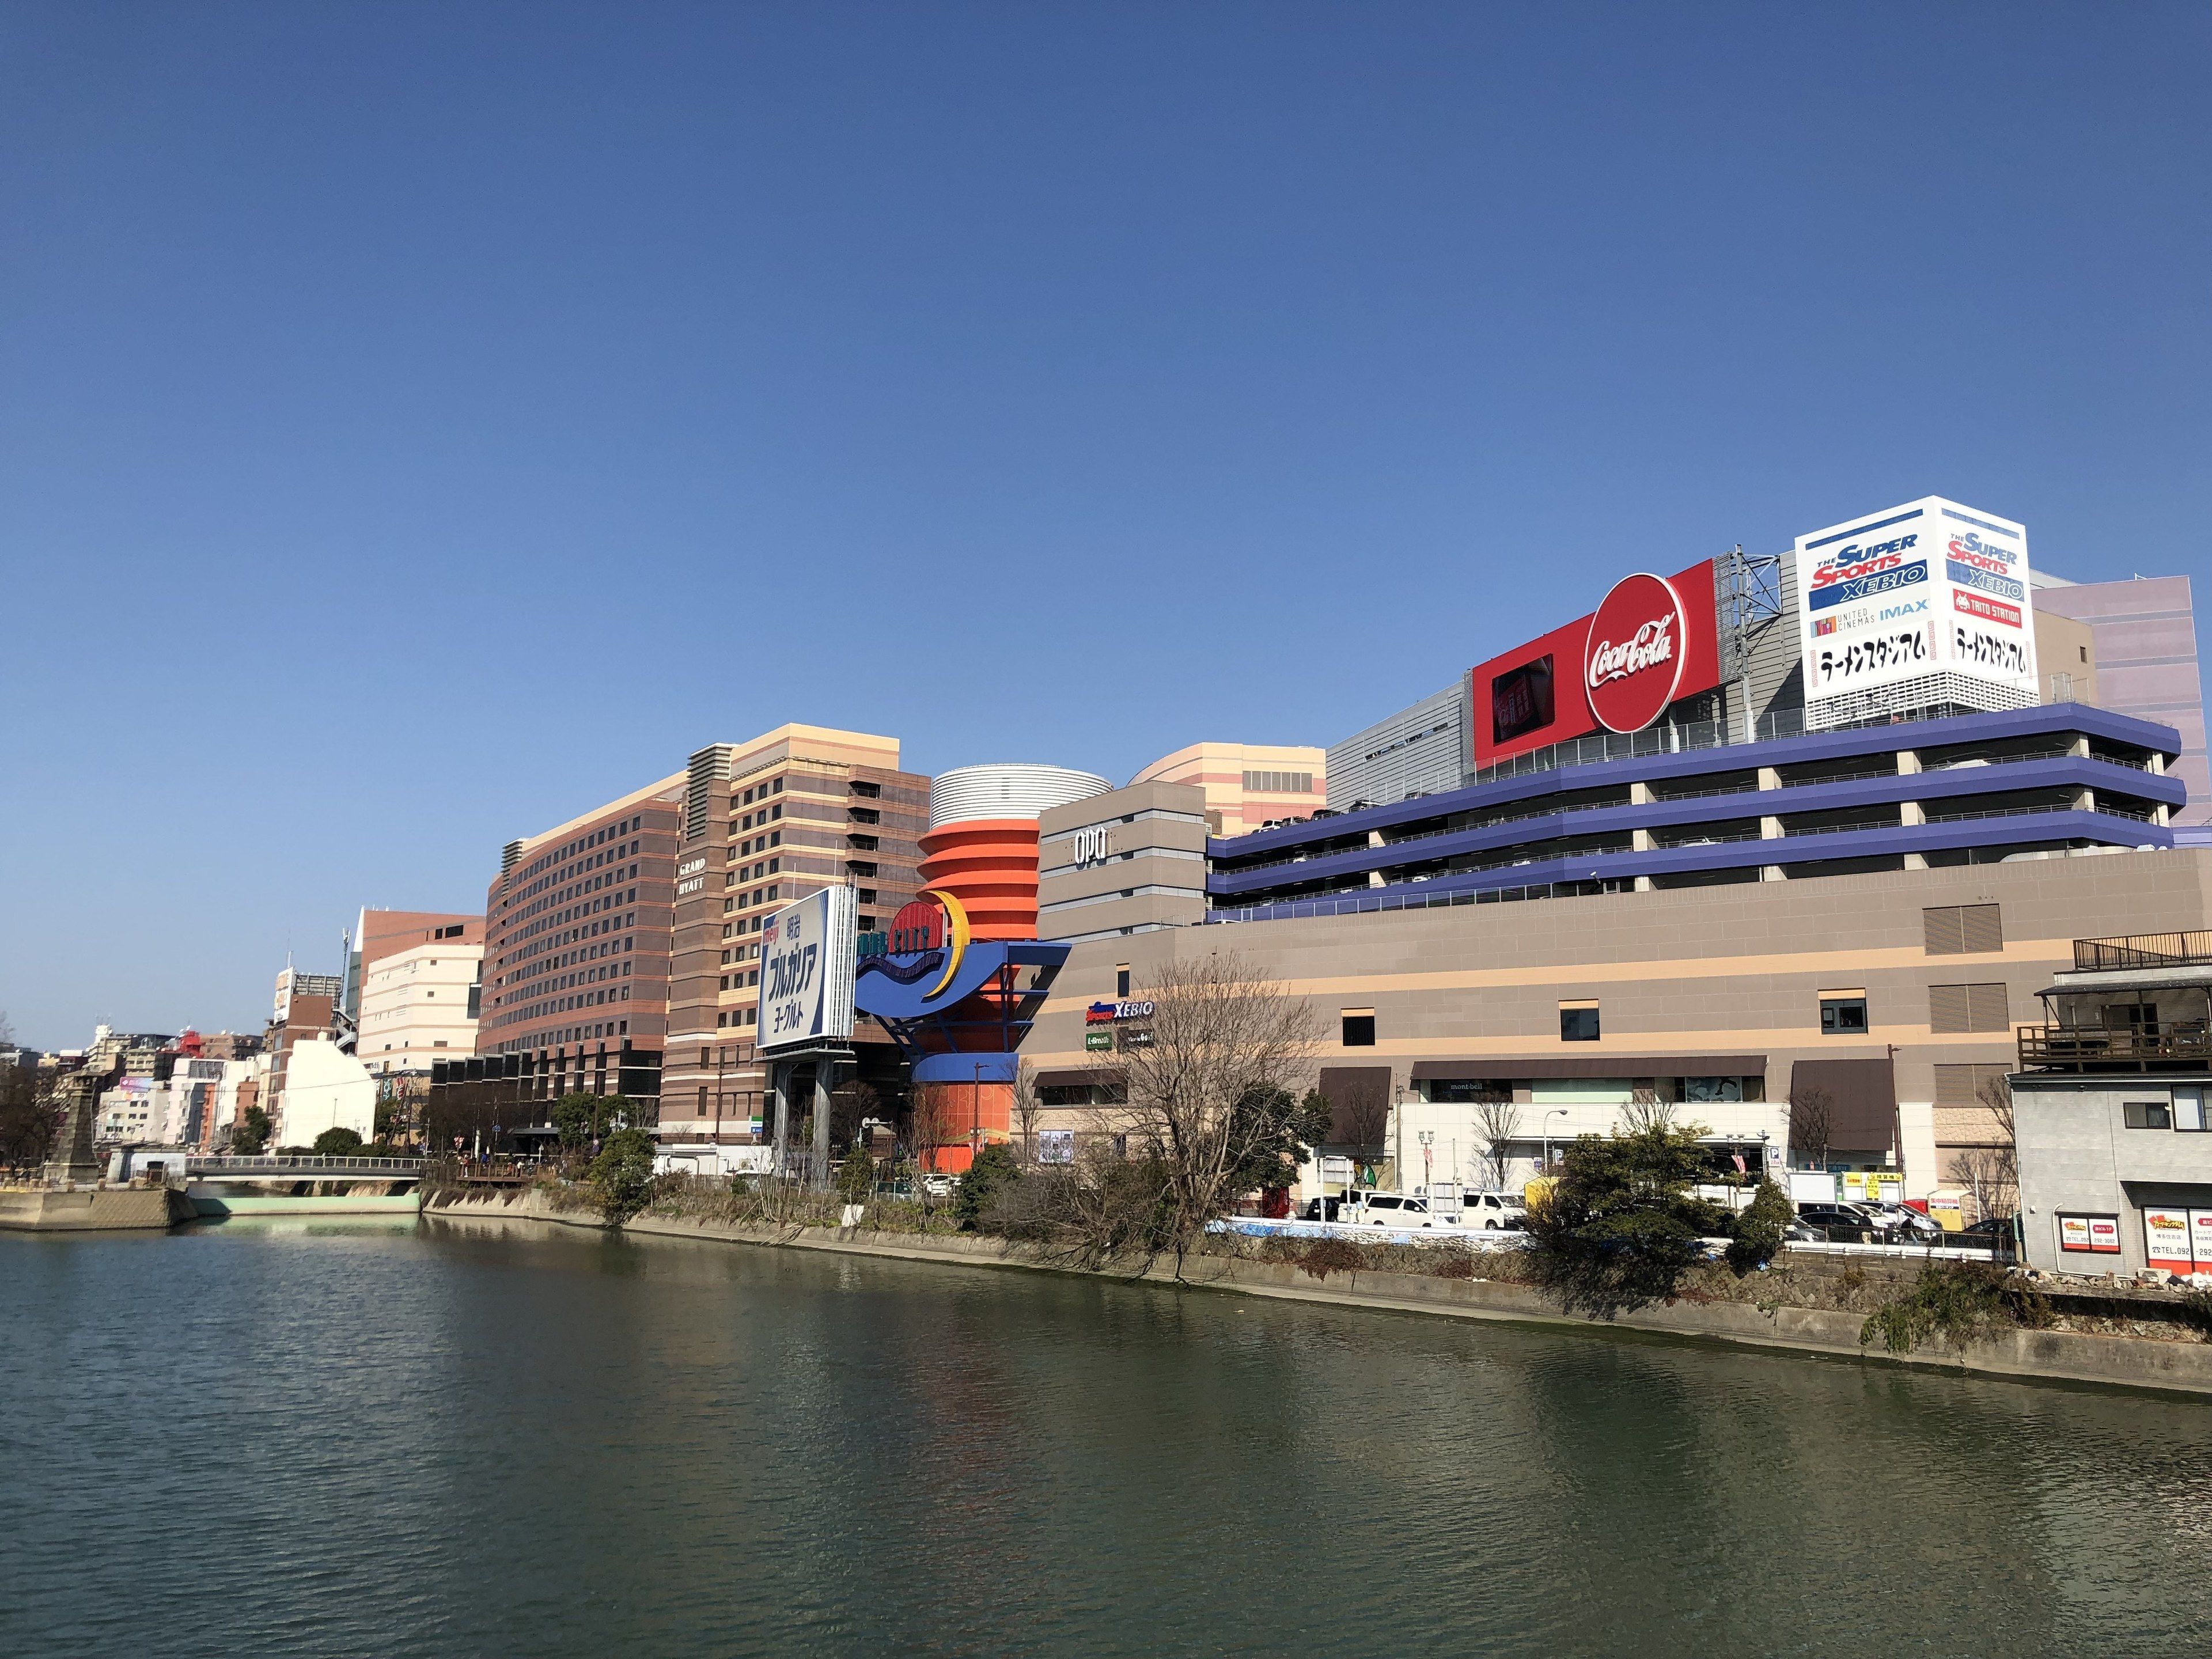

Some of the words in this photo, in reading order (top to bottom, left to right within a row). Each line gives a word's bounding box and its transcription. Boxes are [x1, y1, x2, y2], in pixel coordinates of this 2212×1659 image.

[1817, 557, 1836, 567] THE
[1835, 534, 1918, 568] SUPER
[1947, 540, 2008, 575] SPORTS
[1950, 533, 1965, 541] THE
[1963, 533, 2017, 565] SUPER
[1810, 552, 1902, 589] SPORTS
[1840, 565, 1926, 602] XEBIO
[1968, 569, 2023, 599] XEBIO
[1838, 608, 1868, 623] UNITED
[1838, 615, 1875, 631] CINEMAS
[1880, 599, 1929, 620] IMAX
[1970, 599, 1991, 615] TAITO
[1991, 605, 2020, 623] STATION
[1821, 630, 1926, 682] ラーメンスタジアム
[1957, 627, 2026, 673] ラーメンスタジアム
[680, 858, 706, 876] GRAND
[679, 877, 704, 895] HYATT
[763, 919, 779, 945] meiji
[787, 913, 801, 941] 明治
[893, 926, 930, 951] CITY
[768, 942, 817, 1002] ブルガリア
[774, 998, 804, 1033] ヨーグルト
[1113, 1001, 1153, 1018] XEBIO
[1771, 1149, 1778, 1158] P
[2161, 1247, 2190, 1255] TEL.092
